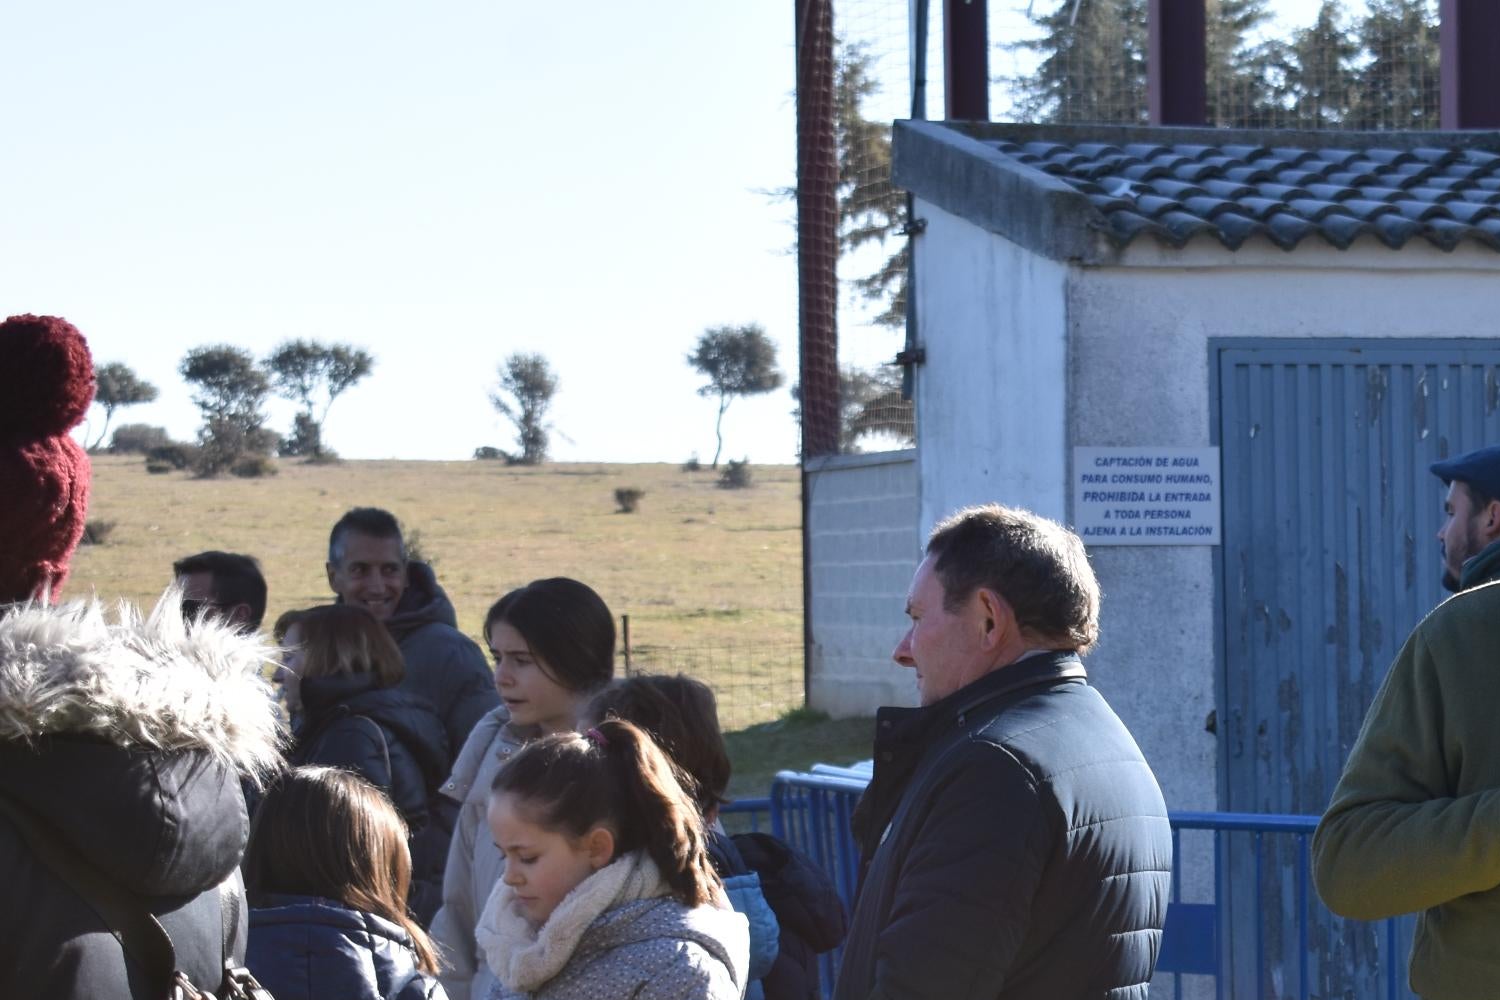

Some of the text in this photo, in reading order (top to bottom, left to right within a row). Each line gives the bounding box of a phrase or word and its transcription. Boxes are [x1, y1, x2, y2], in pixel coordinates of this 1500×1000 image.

[1095, 456, 1199, 467] CAPTACIÓN DE AGUA
[1082, 474, 1212, 486] PARA CONSUMO HUMANO,
[1083, 492, 1211, 502] PROHIBIDA LA ENTRADA
[1104, 510, 1191, 519] A TODA PERSONA
[1084, 525, 1212, 536] AJENA A LA INSTALACIÓN
